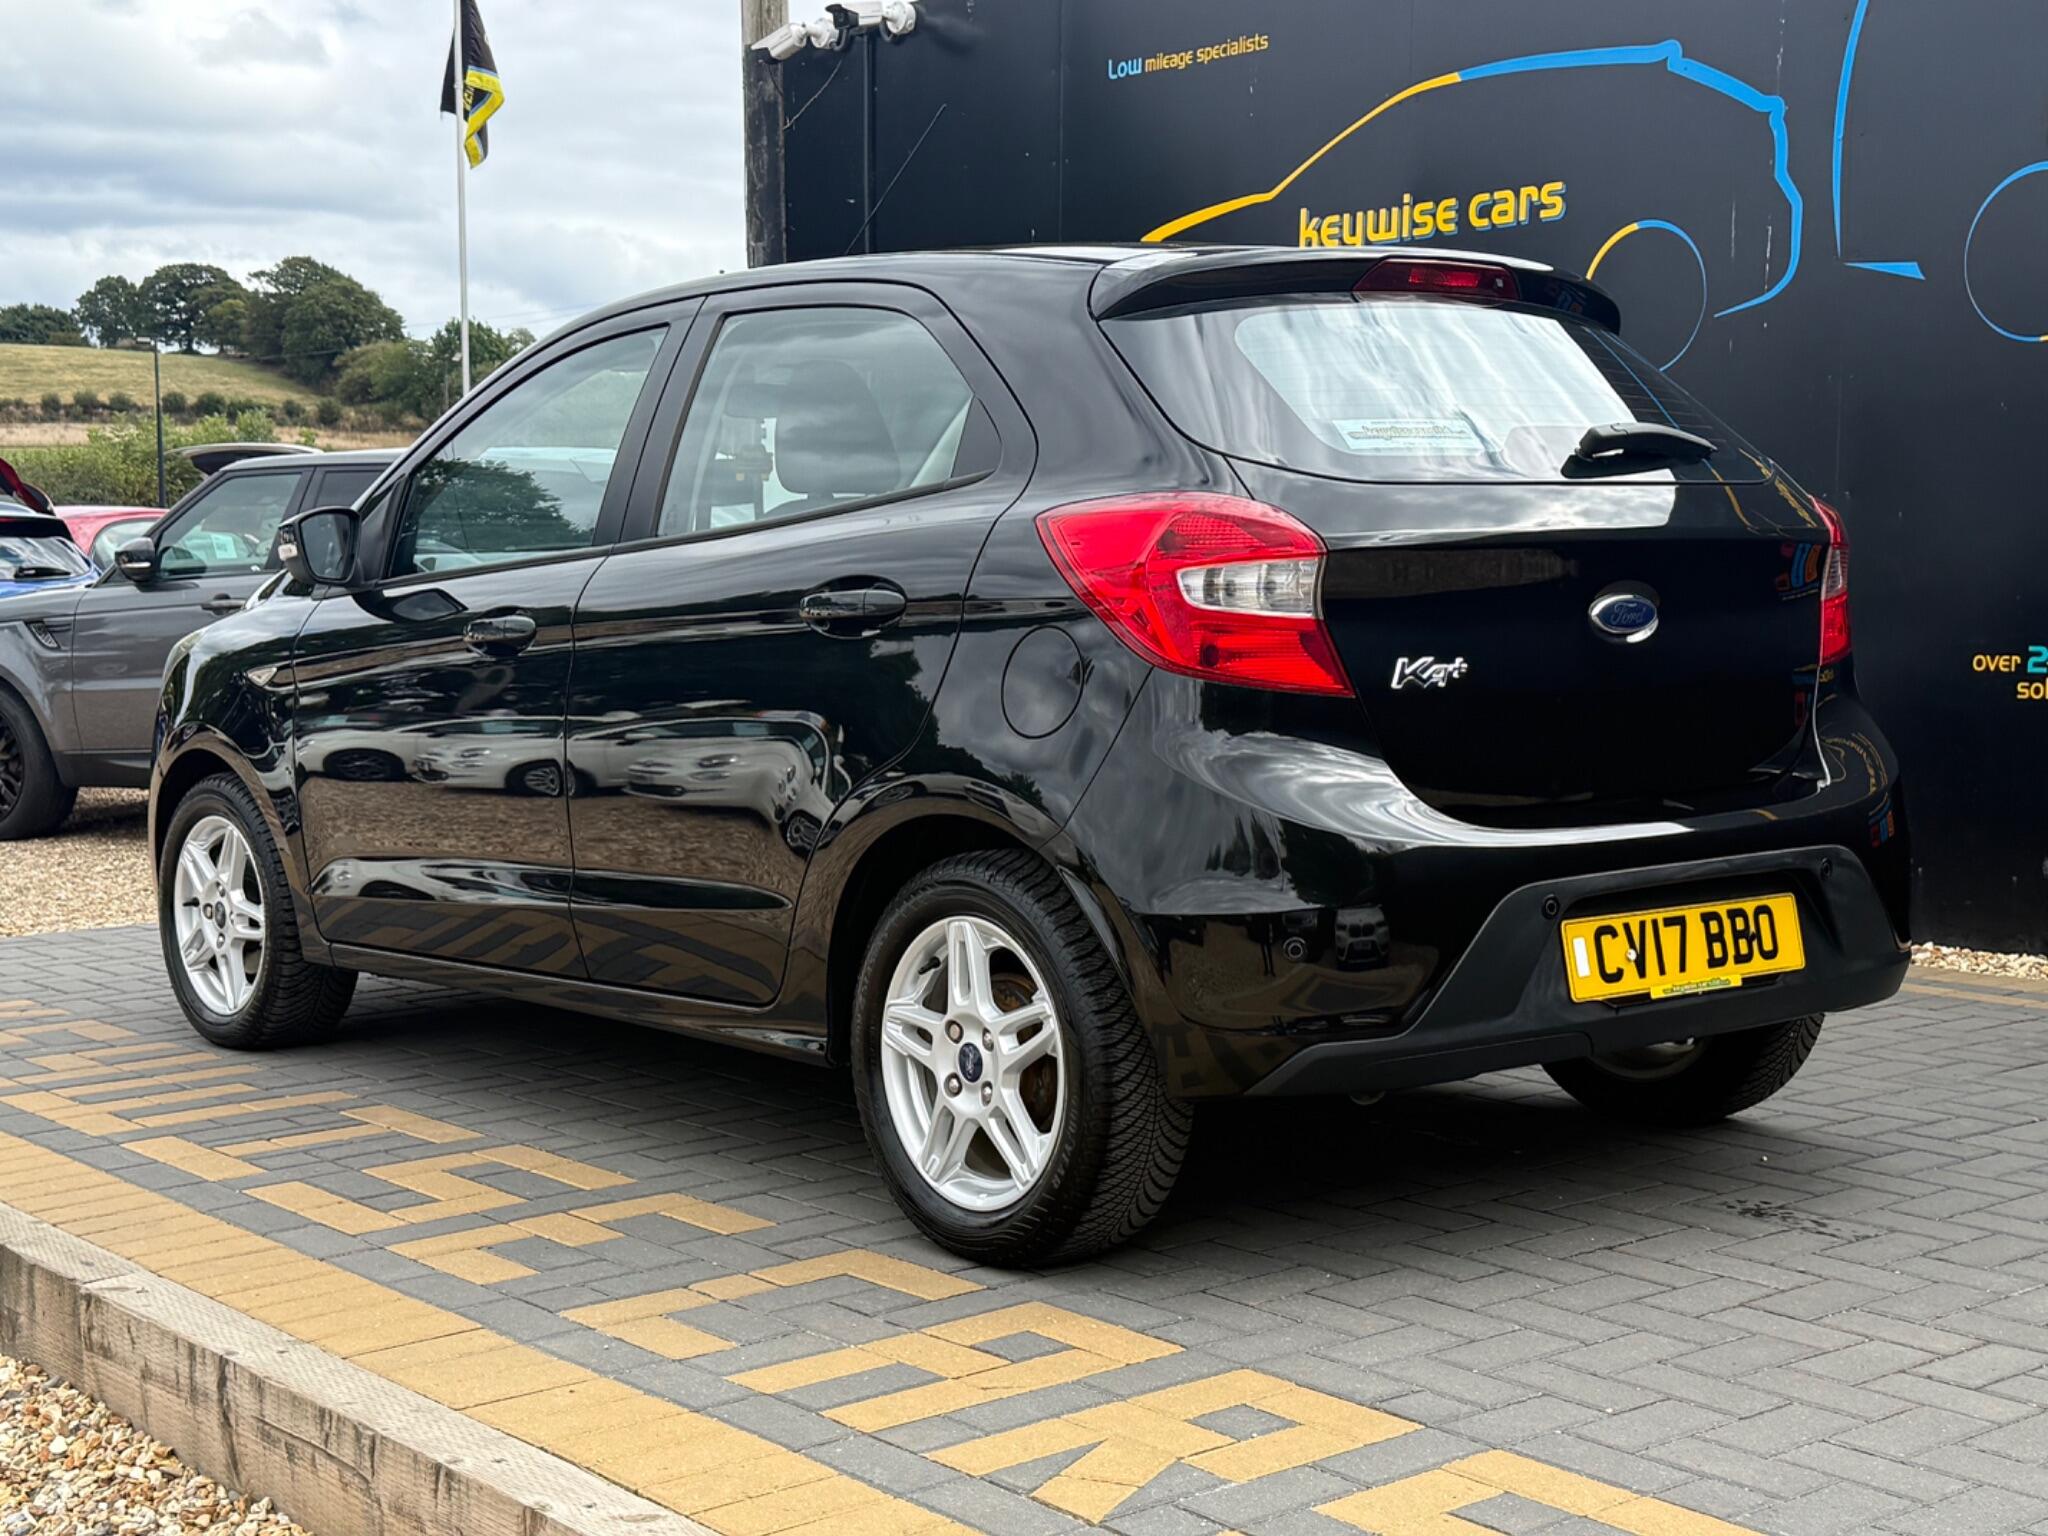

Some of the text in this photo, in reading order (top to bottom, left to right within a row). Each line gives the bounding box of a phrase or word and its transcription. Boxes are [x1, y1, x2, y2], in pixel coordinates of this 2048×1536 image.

[1108, 33, 1270, 80] Low mileage specialists
[1299, 181, 1567, 248] keywise cars
[1609, 601, 1650, 627] Ford
[1391, 656, 1468, 689] Ka+
[2026, 645, 2048, 674] 2
[1593, 905, 1779, 985] CV17 BBO
